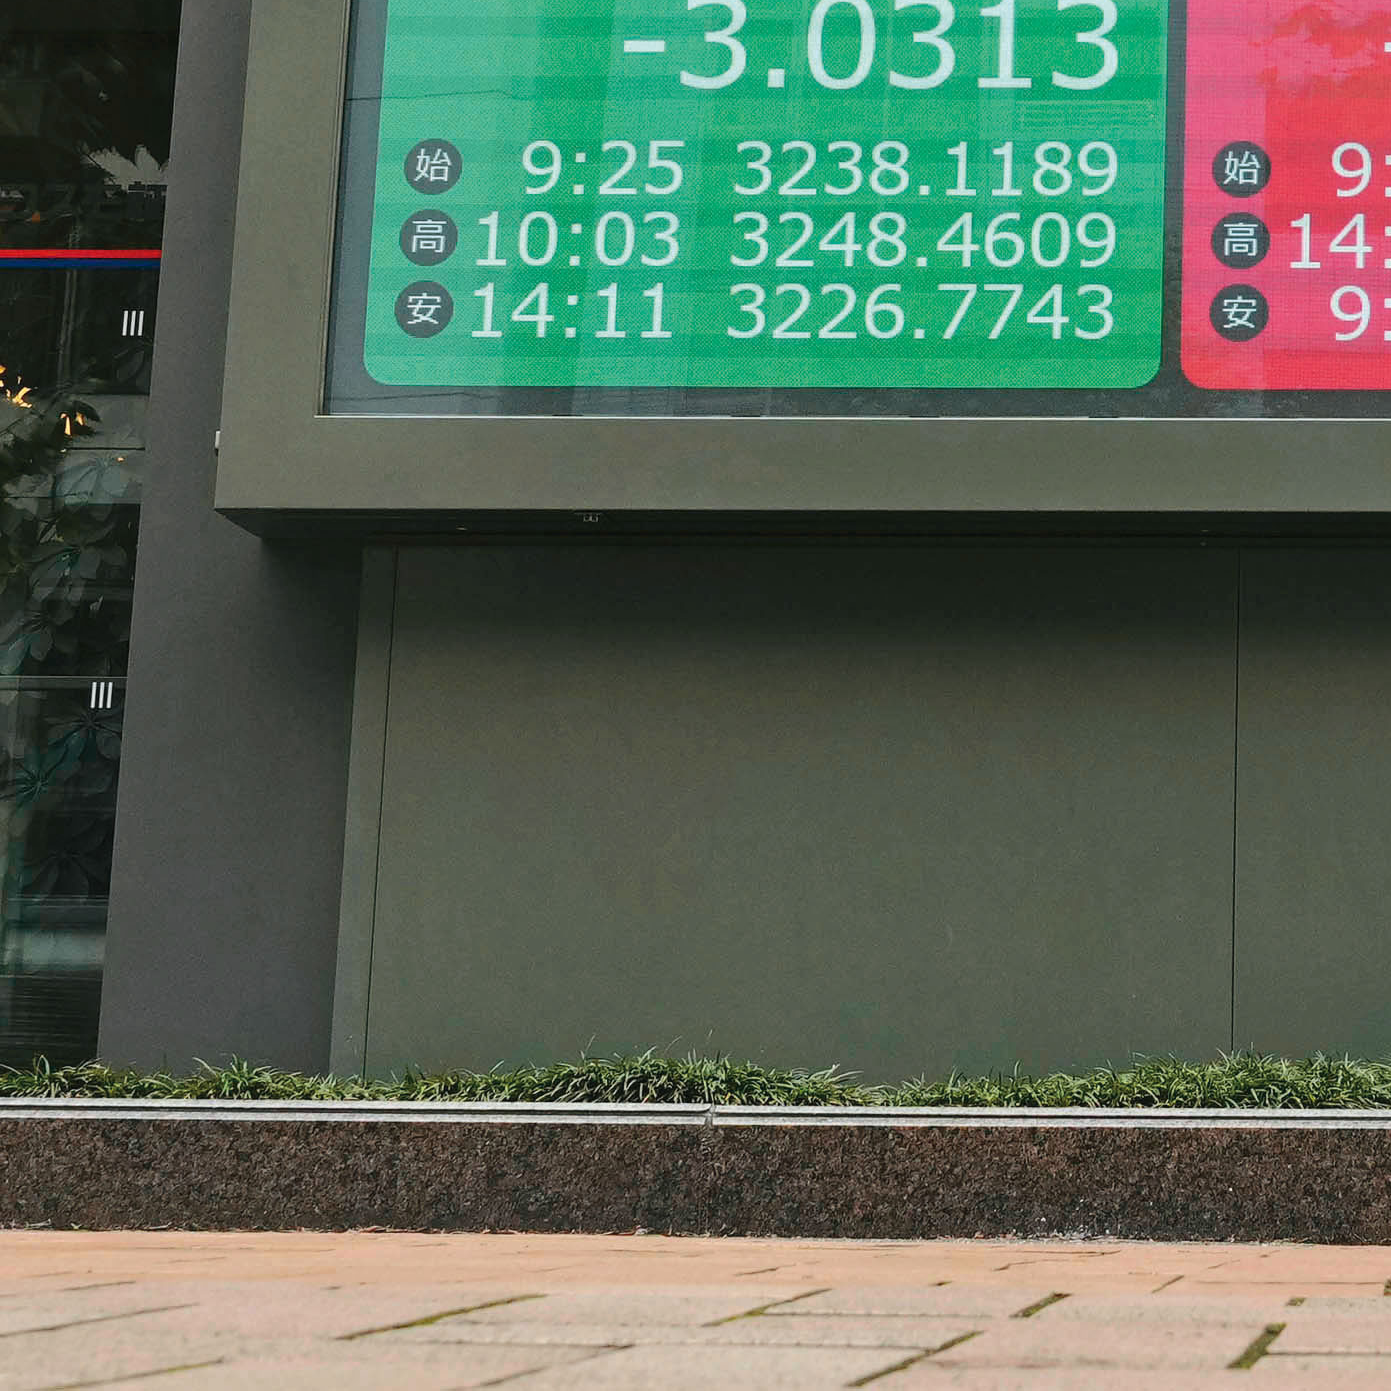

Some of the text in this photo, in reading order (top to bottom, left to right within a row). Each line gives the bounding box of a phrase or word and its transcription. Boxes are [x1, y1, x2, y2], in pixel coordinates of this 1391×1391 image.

[413, 139, 1118, 197] 始 9:25 3238.1189
[1223, 150, 1261, 185] 始
[411, 210, 1117, 268] 高 10:03 3248.4609
[1223, 222, 1259, 257] 高
[407, 281, 1114, 340] 安 14:11 3226.7743
[1222, 295, 1257, 329] 安
